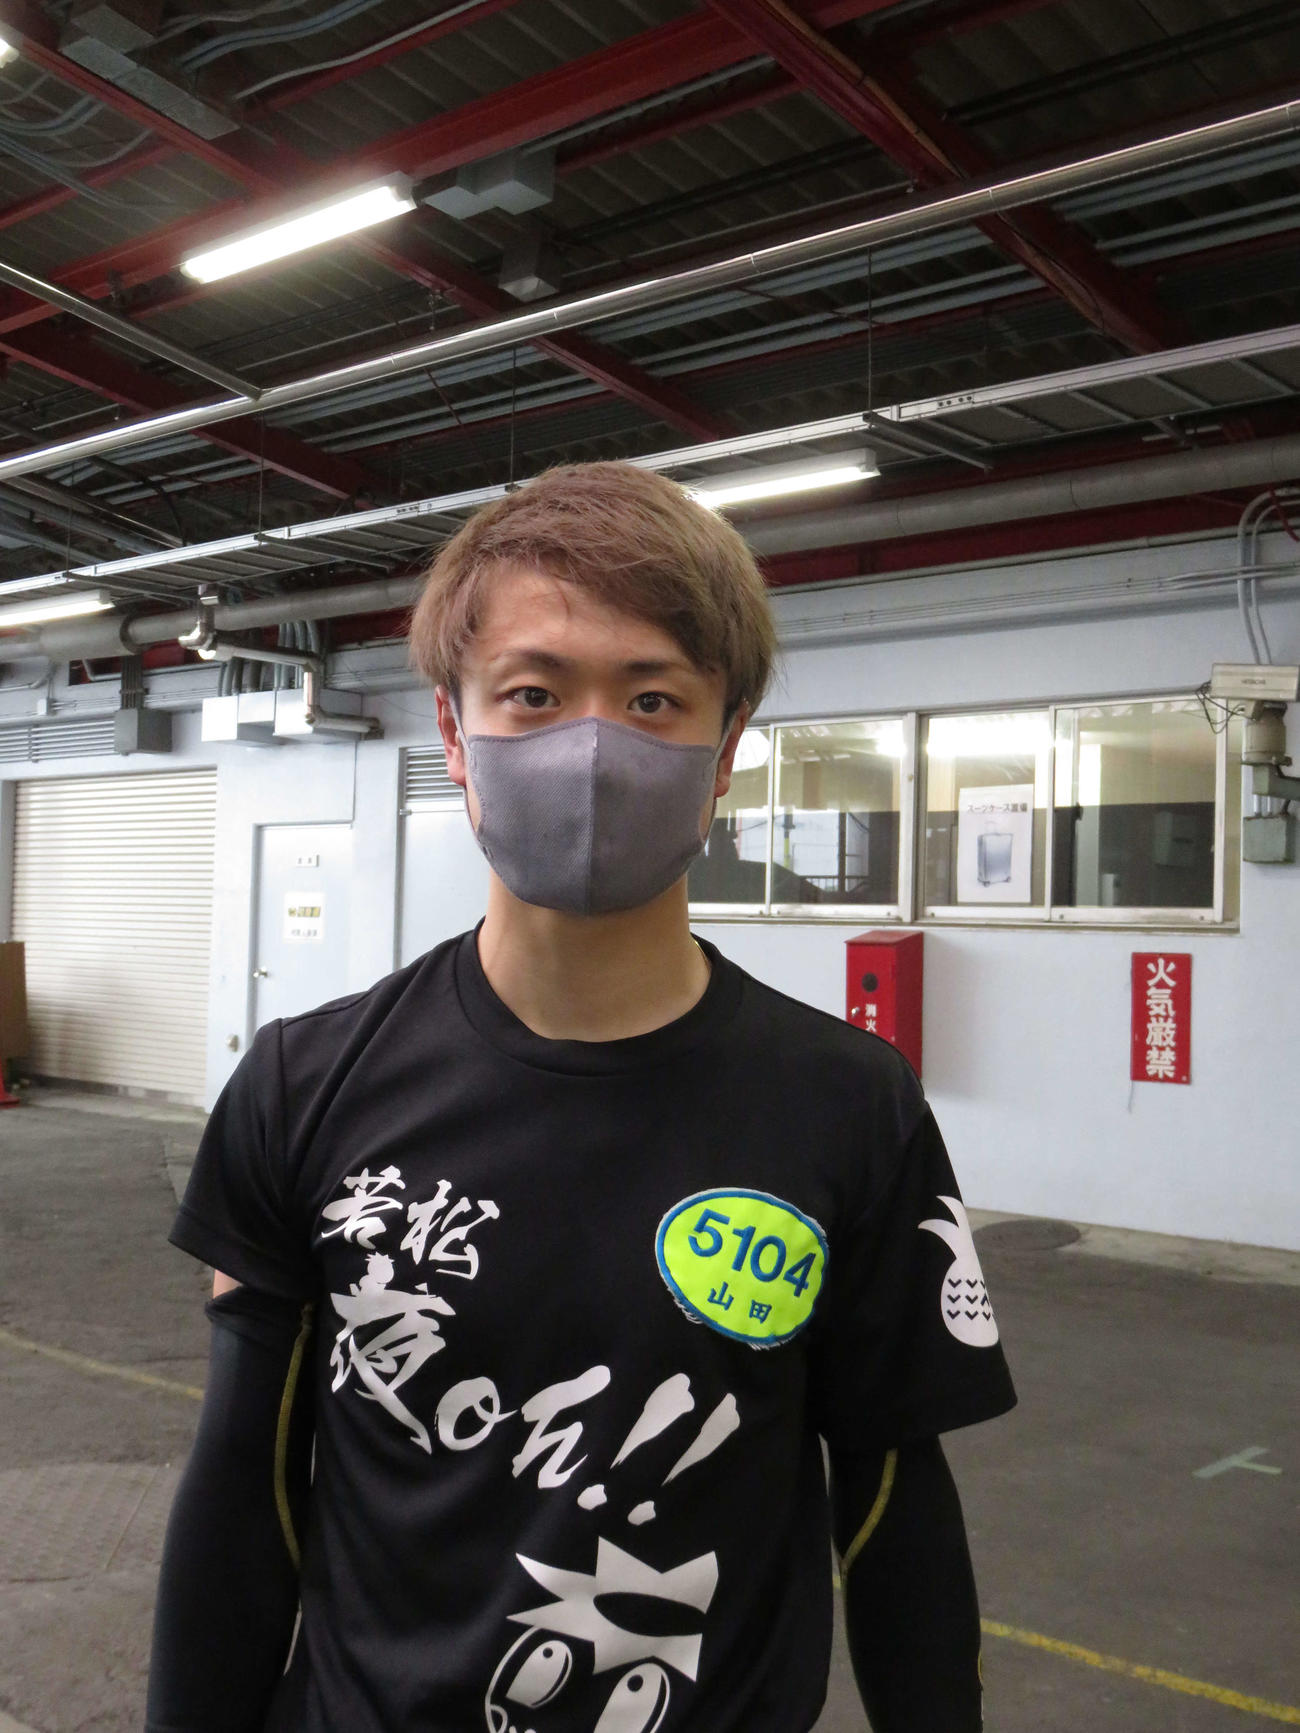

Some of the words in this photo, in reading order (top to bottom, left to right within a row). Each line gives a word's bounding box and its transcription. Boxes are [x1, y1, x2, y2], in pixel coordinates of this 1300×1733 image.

[1145, 957, 1177, 1079] 火気厳禁
[321, 1165, 500, 1280] 若松
[688, 1208, 816, 1298] 5104
[707, 1281, 773, 1324] 山田
